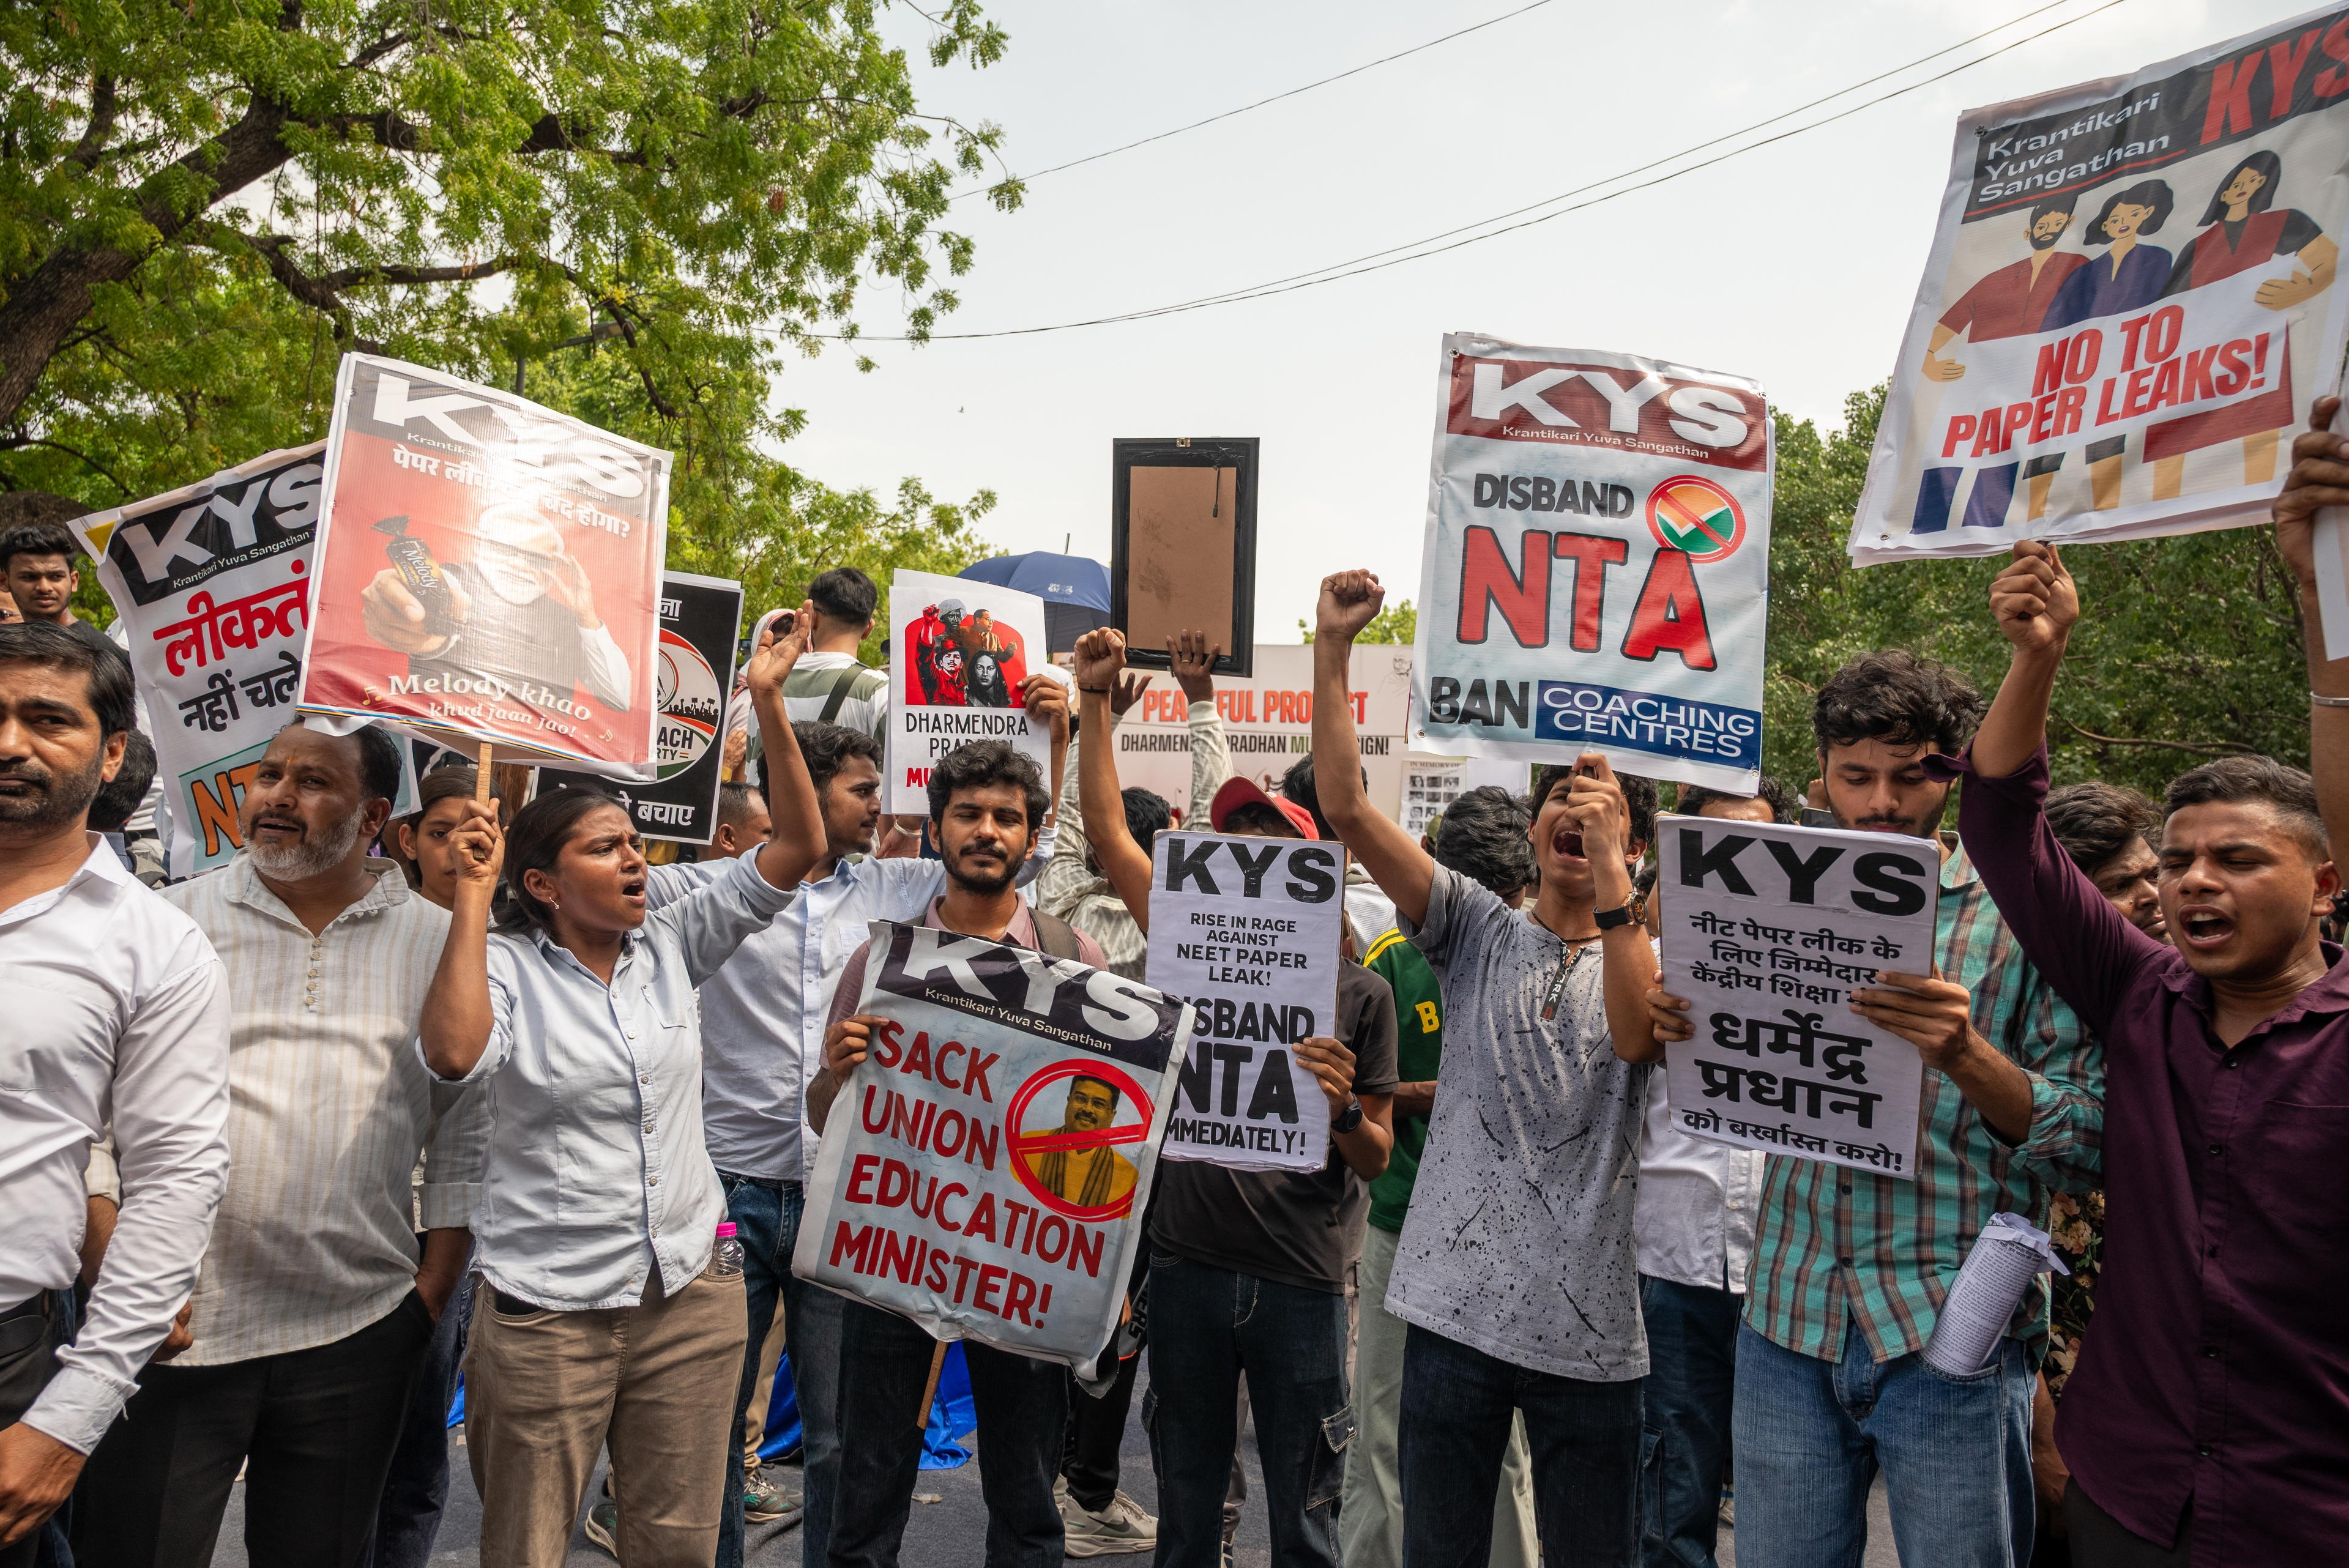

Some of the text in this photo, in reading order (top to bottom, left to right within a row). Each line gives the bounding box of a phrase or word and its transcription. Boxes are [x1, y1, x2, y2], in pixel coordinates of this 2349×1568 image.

[2200, 16, 2349, 146] KYS
[1988, 91, 2161, 161] Krantikari
[1978, 134, 2170, 204] Sangathan
[1984, 147, 2064, 182] Yuva
[2031, 305, 2186, 398] NO TO
[1470, 363, 1748, 448] KYS
[1941, 332, 2271, 458] PAPER LEAKS!
[407, 433, 486, 462] Krantika
[1502, 425, 1709, 459] Krantikari Yuva Sangathan
[393, 443, 441, 477] पेपर
[575, 501, 630, 538] होगा?
[1473, 473, 1634, 519] DISBAND
[119, 464, 324, 584] KYS
[173, 531, 310, 589] Krantikari Yuva Sangathan
[403, 549, 440, 588] Melody
[153, 559, 309, 677] लीकतं
[1456, 524, 1718, 672] NTA
[179, 650, 300, 732] नहीं चले
[388, 672, 591, 721] Melody khao
[430, 702, 578, 738] khud jaan jao!
[1143, 690, 1257, 723] PEAFUL
[1429, 676, 1755, 736] BAN COACHING
[657, 726, 693, 749] ACH
[906, 712, 1029, 735] DHARMENDRA
[1122, 734, 1193, 752] DHARMEN
[1553, 712, 1743, 757] CENTRES
[657, 747, 678, 760] RTY
[638, 800, 695, 826] बचाए
[1166, 838, 1336, 904] KYS
[1679, 828, 1927, 916] KYS
[1191, 912, 1297, 933] RISE IN RAGE
[1206, 930, 1279, 947] AGAINST
[1689, 910, 1902, 960] नीट पेपर लीक के
[903, 926, 1163, 1041] KYS
[1177, 944, 1308, 969] NEET PAPER
[1208, 966, 1271, 986] LEAK!
[1690, 962, 1763, 991] केंद्रीय
[1770, 975, 1841, 1004] शिक्षा
[1710, 940, 1879, 984] लिए जिम्मेदार
[925, 987, 1112, 1052] Krantikari Yuva Sangathan
[1415, 1000, 1440, 1033] B
[874, 1019, 1000, 1104] SACK
[1709, 1008, 1873, 1085] धर्मेंद्र
[1175, 1041, 1299, 1124] NTA
[1695, 1058, 1883, 1129] प्रधान
[862, 1084, 999, 1171] UNION
[1166, 1118, 1306, 1156] MMEDIATELY!
[1681, 1107, 1902, 1172] को बर्खास्त करो!
[844, 1154, 1105, 1278] EDUCATION
[828, 1220, 1053, 1329] MINISTER!
